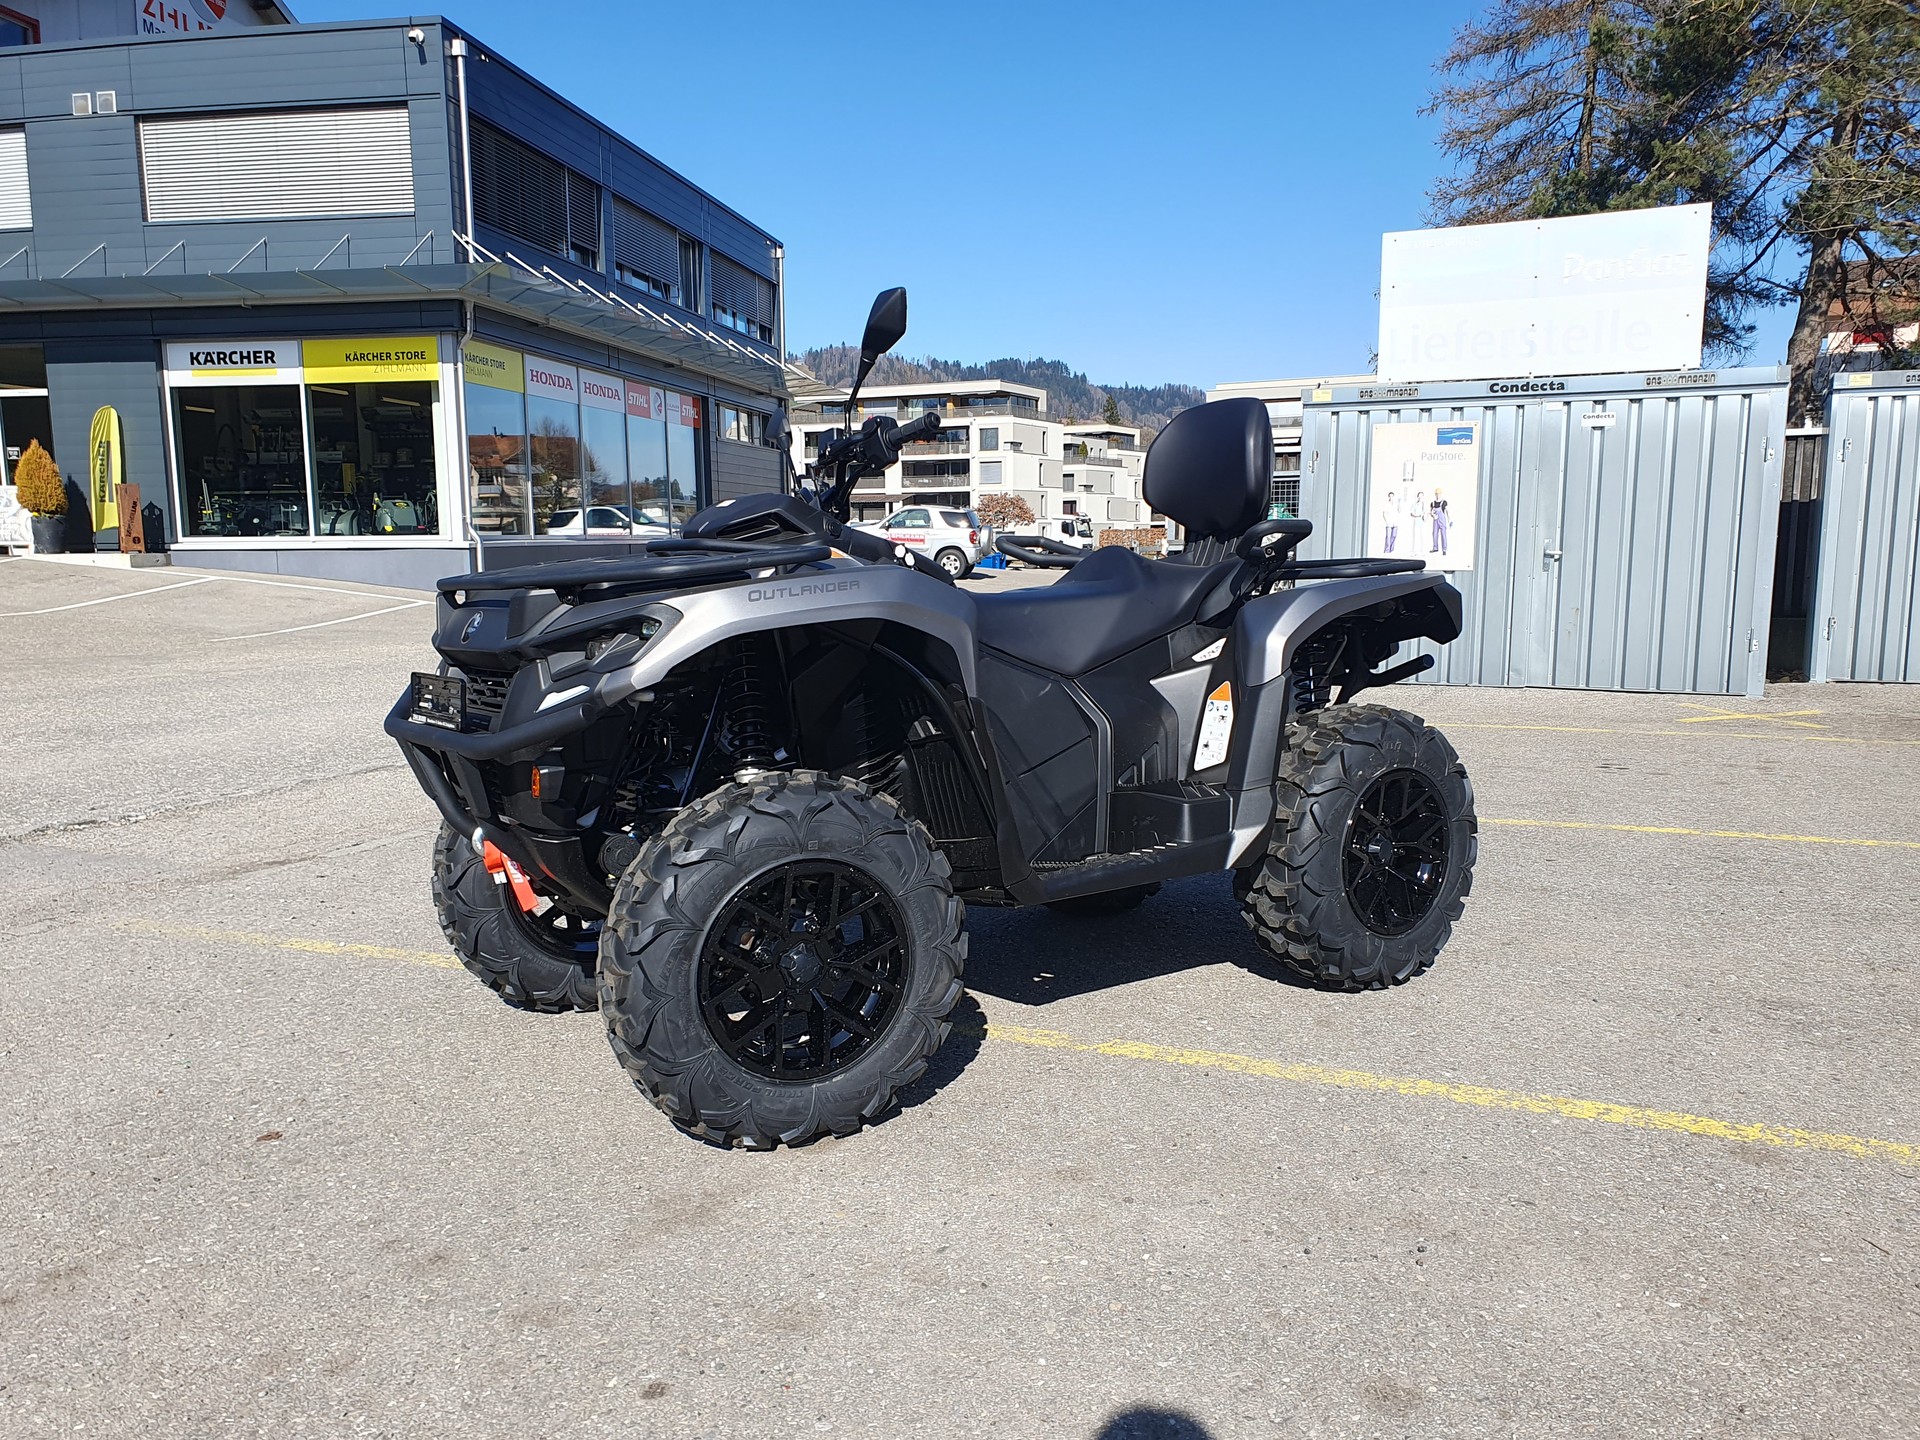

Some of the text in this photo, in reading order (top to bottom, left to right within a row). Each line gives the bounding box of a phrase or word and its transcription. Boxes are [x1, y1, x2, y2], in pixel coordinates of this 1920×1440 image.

[1562, 246, 1694, 284] PanGas
[1389, 308, 1653, 365] Lieferstelle
[189, 350, 277, 366] KÄRCHER
[345, 351, 427, 362] KÄRCHER STORE
[465, 352, 506, 371] KÄRCHER STORE
[374, 363, 427, 374] ZIHLMANN
[529, 368, 574, 391] HONDA
[1489, 380, 1565, 394] Condecta
[583, 381, 622, 401] HONDA
[628, 391, 648, 408] STIHL
[681, 404, 699, 419] STIHL
[748, 580, 860, 602] OUTLANDER
